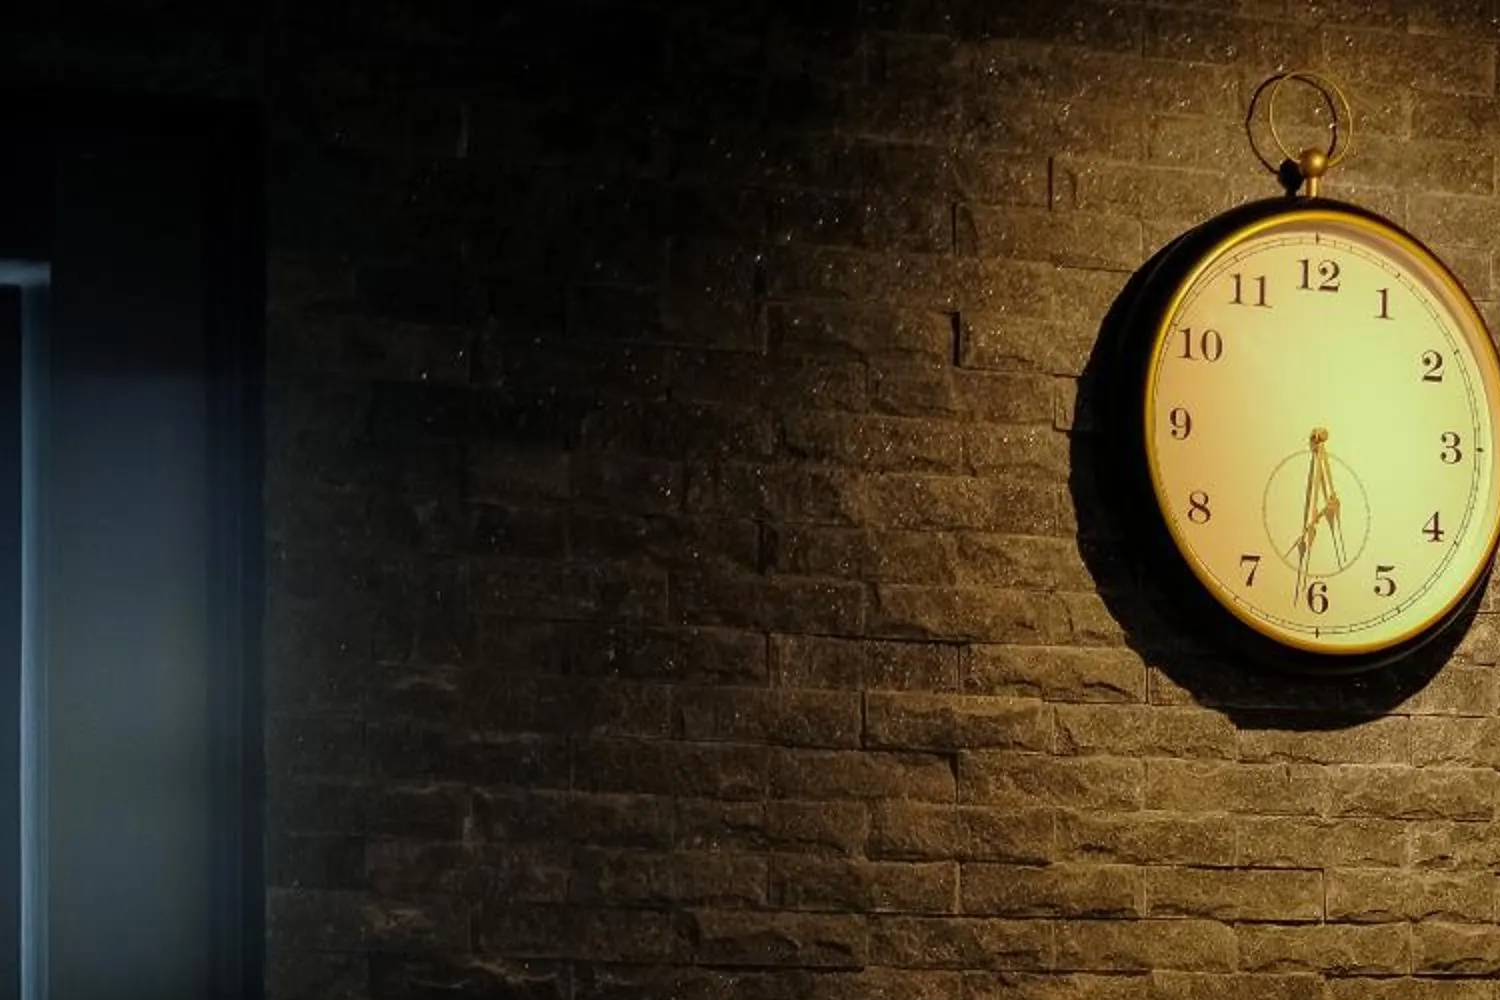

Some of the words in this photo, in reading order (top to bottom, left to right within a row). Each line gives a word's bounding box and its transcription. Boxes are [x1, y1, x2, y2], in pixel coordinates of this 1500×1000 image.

[1228, 273, 1273, 309] 11
[1296, 259, 1340, 293] 12
[1374, 287, 1396, 321] 1
[1177, 328, 1223, 363] 10
[1421, 350, 1444, 383] 2
[1169, 407, 1192, 440] 9
[1440, 432, 1463, 464] 3
[1187, 491, 1212, 524] 8
[1421, 511, 1445, 543] 4
[1239, 554, 1261, 587] 7
[1374, 565, 1397, 597] 5
[1306, 582, 1329, 615] 6
